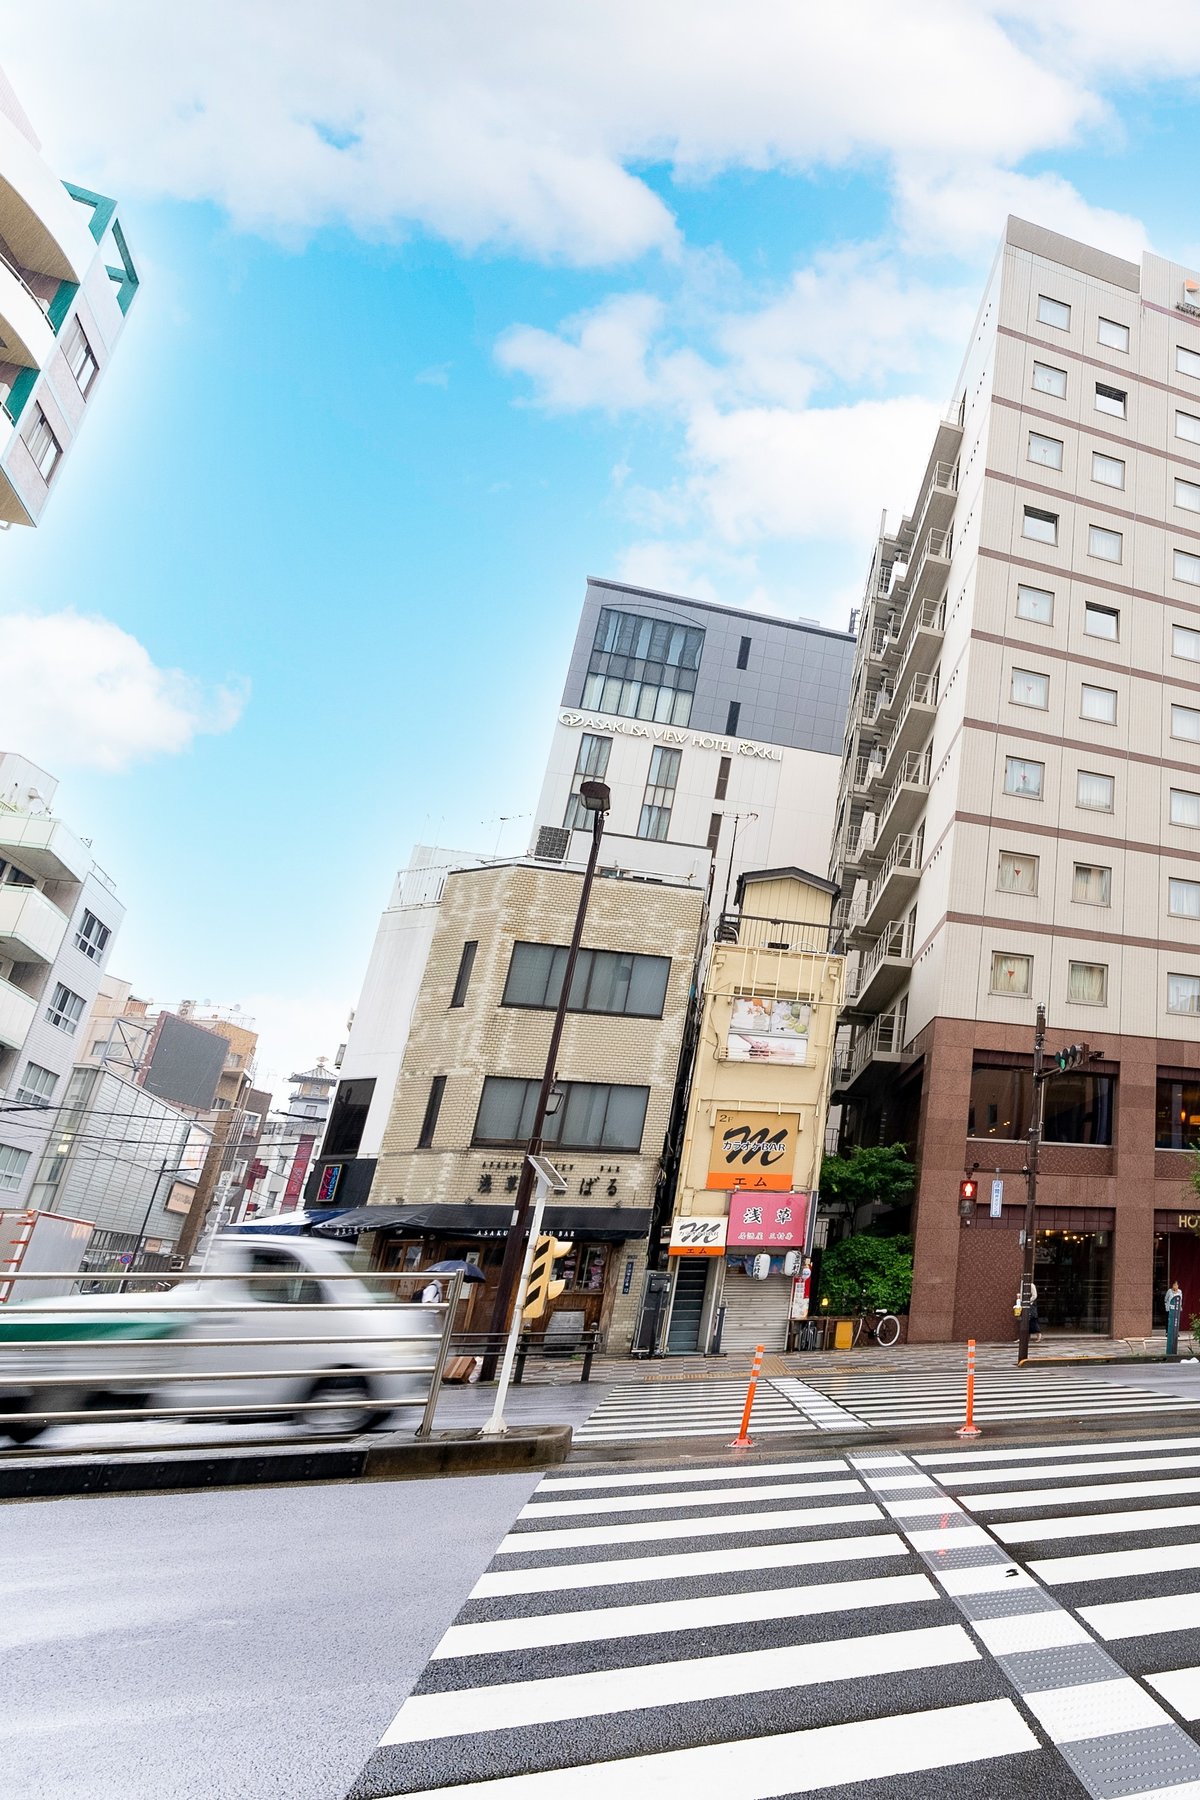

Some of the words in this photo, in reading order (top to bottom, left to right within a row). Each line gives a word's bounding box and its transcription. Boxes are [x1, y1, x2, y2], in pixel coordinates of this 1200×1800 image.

[584, 718, 650, 738] ASAKUSA
[652, 727, 689, 744] VIEW
[692, 736, 734, 753] HOTEL
[719, 1114, 733, 1122] 2F
[723, 1141, 786, 1151] カラオケBAR
[478, 1173, 617, 1196] 浅草ばる
[732, 1177, 767, 1187] エム
[743, 1207, 793, 1225] 浅草
